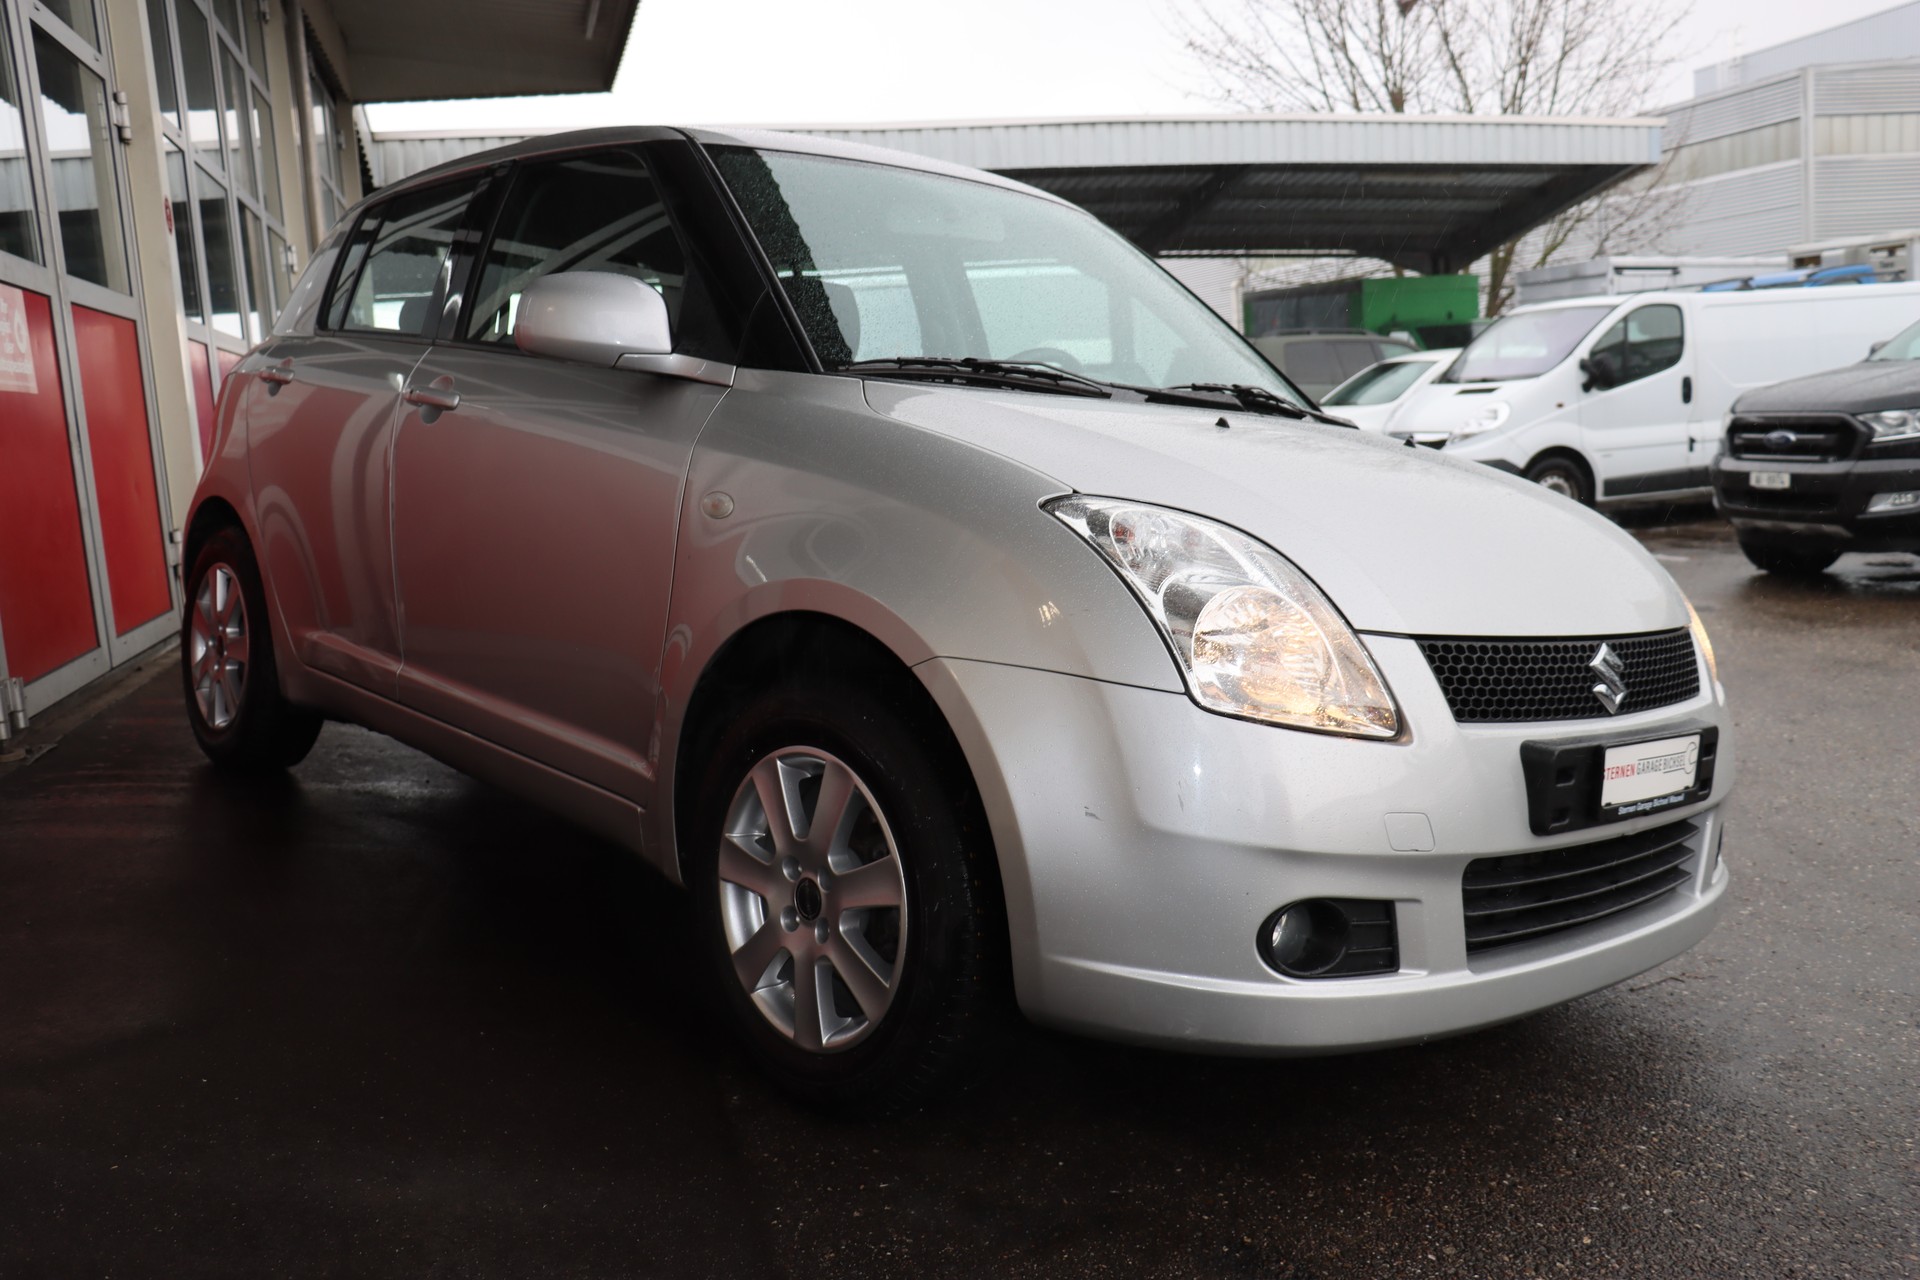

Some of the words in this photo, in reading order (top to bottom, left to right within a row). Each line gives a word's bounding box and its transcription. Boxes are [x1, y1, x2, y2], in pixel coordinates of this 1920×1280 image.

[1604, 763, 1635, 780] TERNEN
[1637, 758, 1662, 775] GARAGE
[1663, 755, 1685, 770] BICHSEL
[1618, 806, 1636, 815] Sternen
[1637, 802, 1653, 811] Garage
